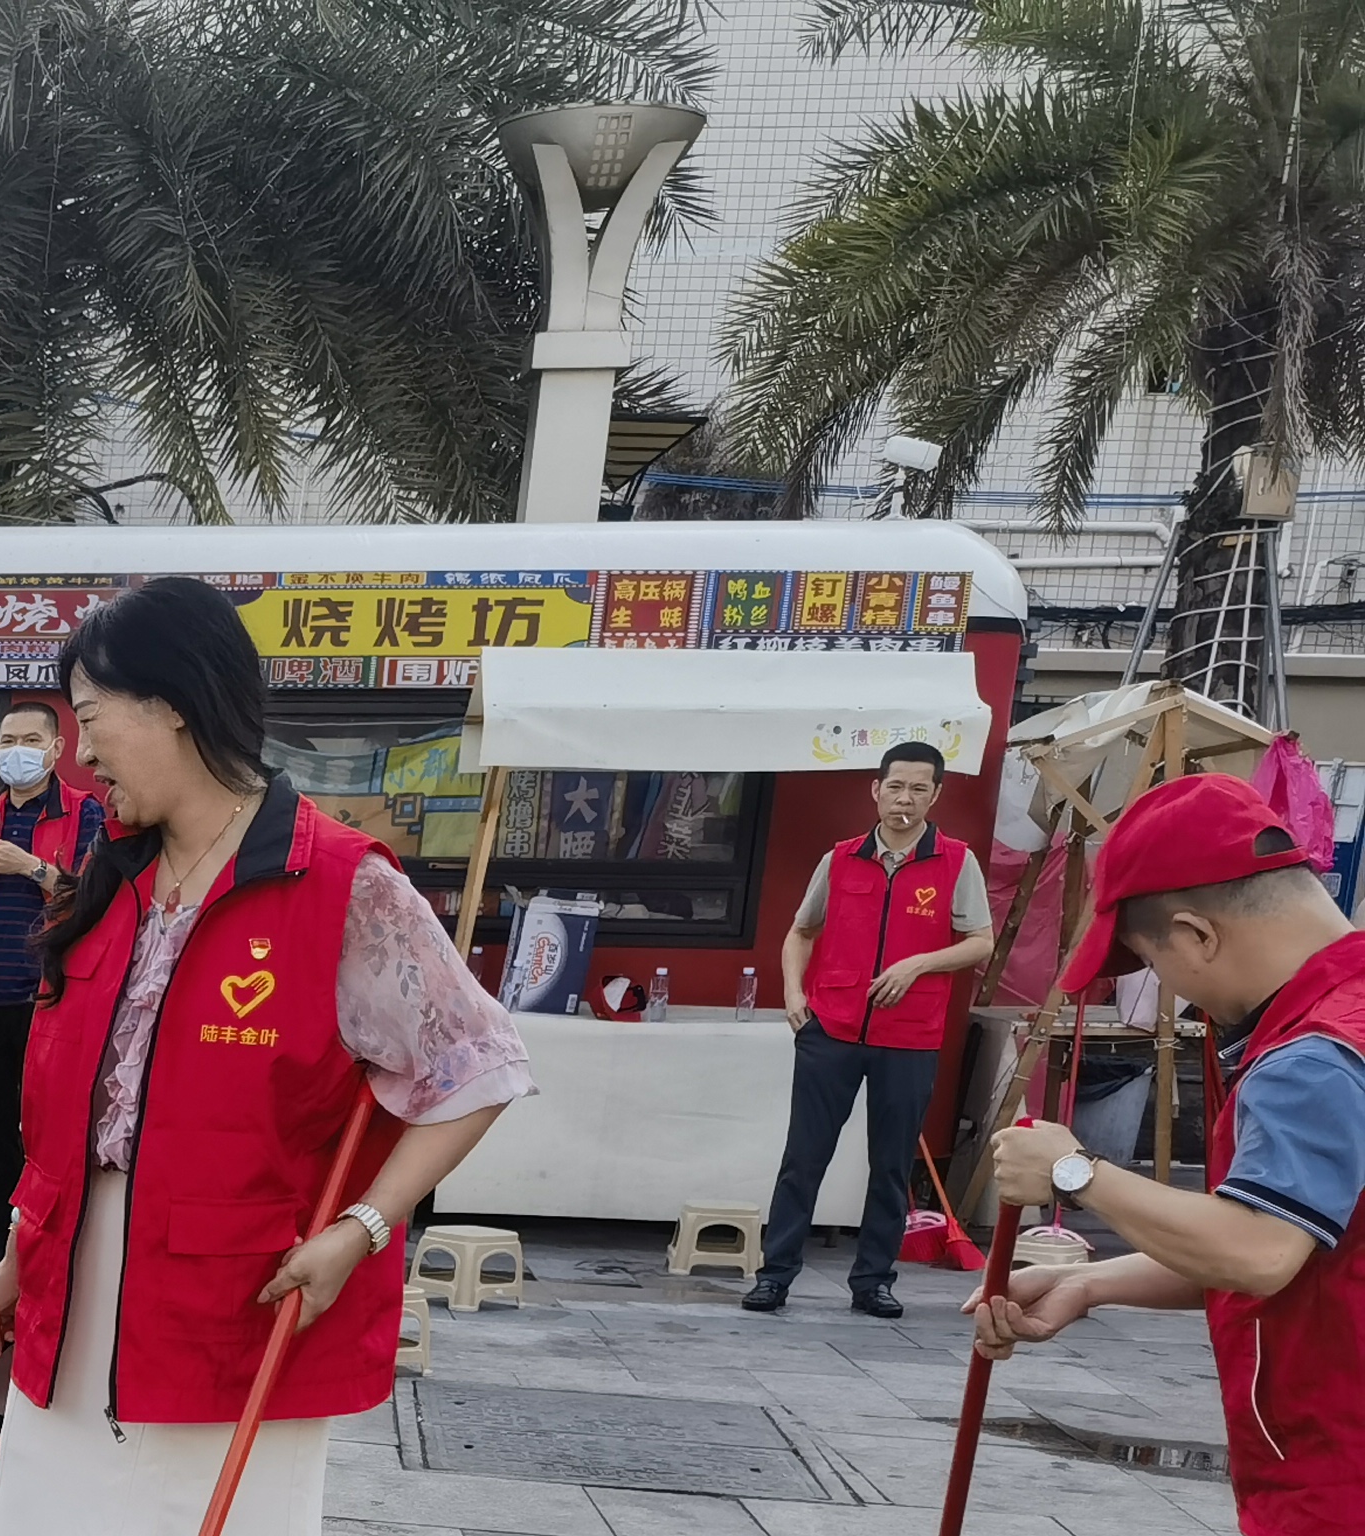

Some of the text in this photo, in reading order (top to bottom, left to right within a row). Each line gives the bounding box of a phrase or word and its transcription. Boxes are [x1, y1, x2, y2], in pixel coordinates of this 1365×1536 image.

[289, 573, 420, 585] 金不换牛肉
[613, 578, 687, 602] 高压锅
[727, 578, 771, 601] 鸭血
[806, 577, 842, 624] 钉螺
[861, 573, 904, 626] 小青桔
[925, 575, 961, 627] 鳗鱼串
[280, 596, 545, 648] 烧烤坊
[609, 605, 683, 629] 生蚝
[722, 604, 769, 627] 粉丝
[269, 657, 364, 684] 啤酒
[850, 726, 928, 748] 德智天地
[199, 1023, 280, 1048] 陆丰金叶
